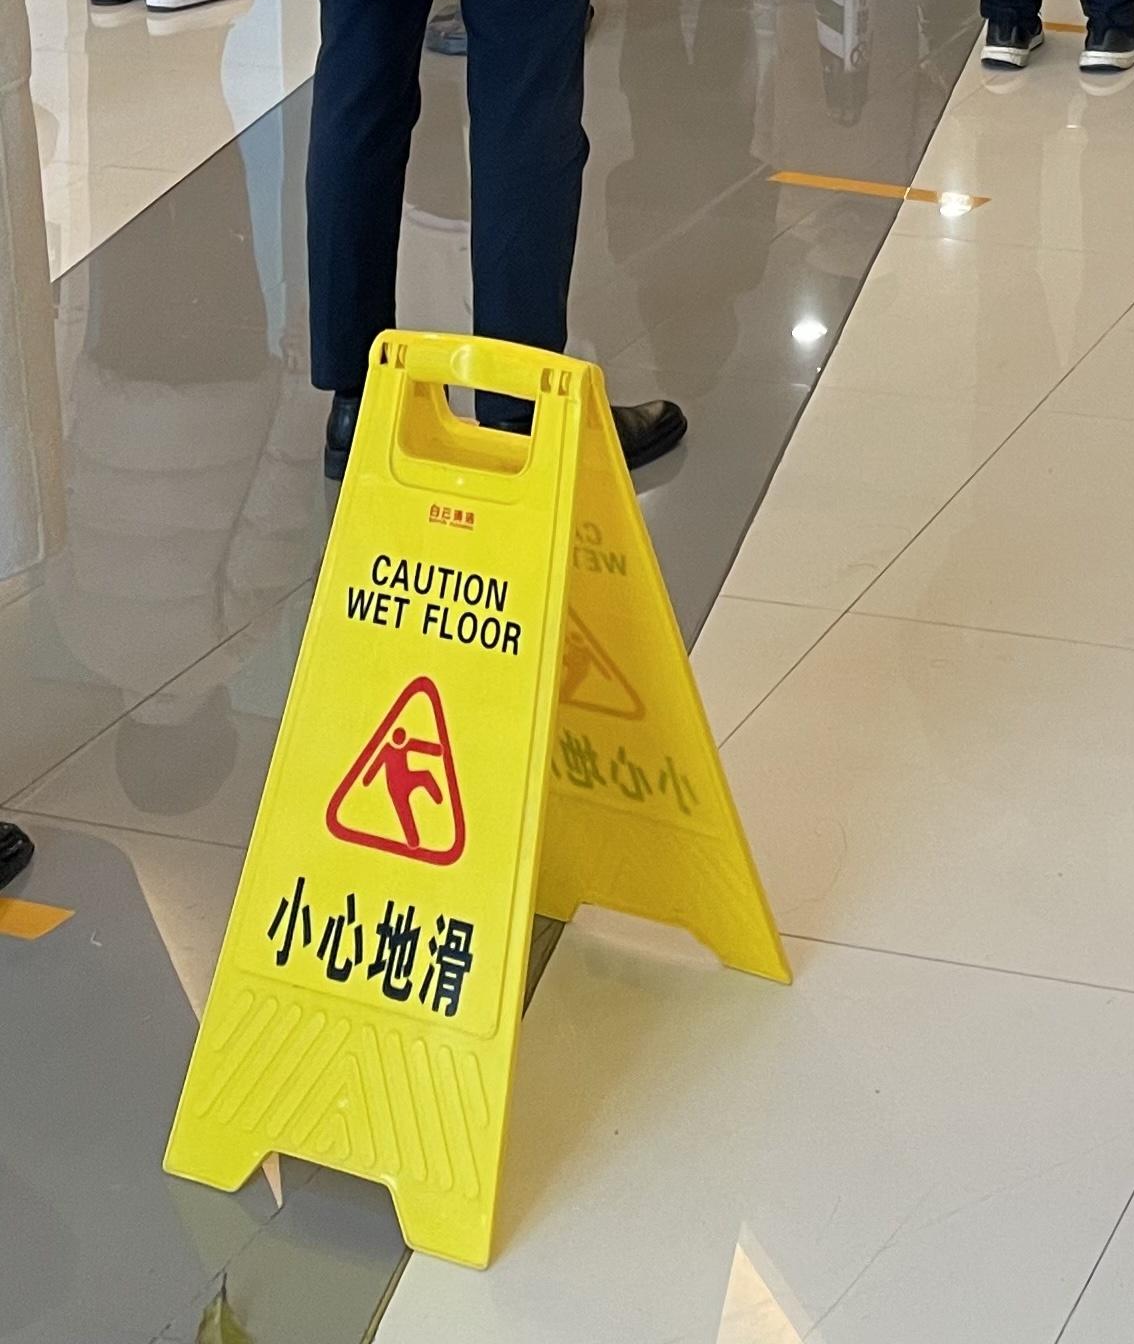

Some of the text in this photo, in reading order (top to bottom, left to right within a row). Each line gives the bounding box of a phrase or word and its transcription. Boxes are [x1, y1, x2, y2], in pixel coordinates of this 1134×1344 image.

[371, 554, 508, 613] CAUTION
[347, 586, 522, 656] WET FLOOR
[267, 876, 475, 1018] 小心地滑
